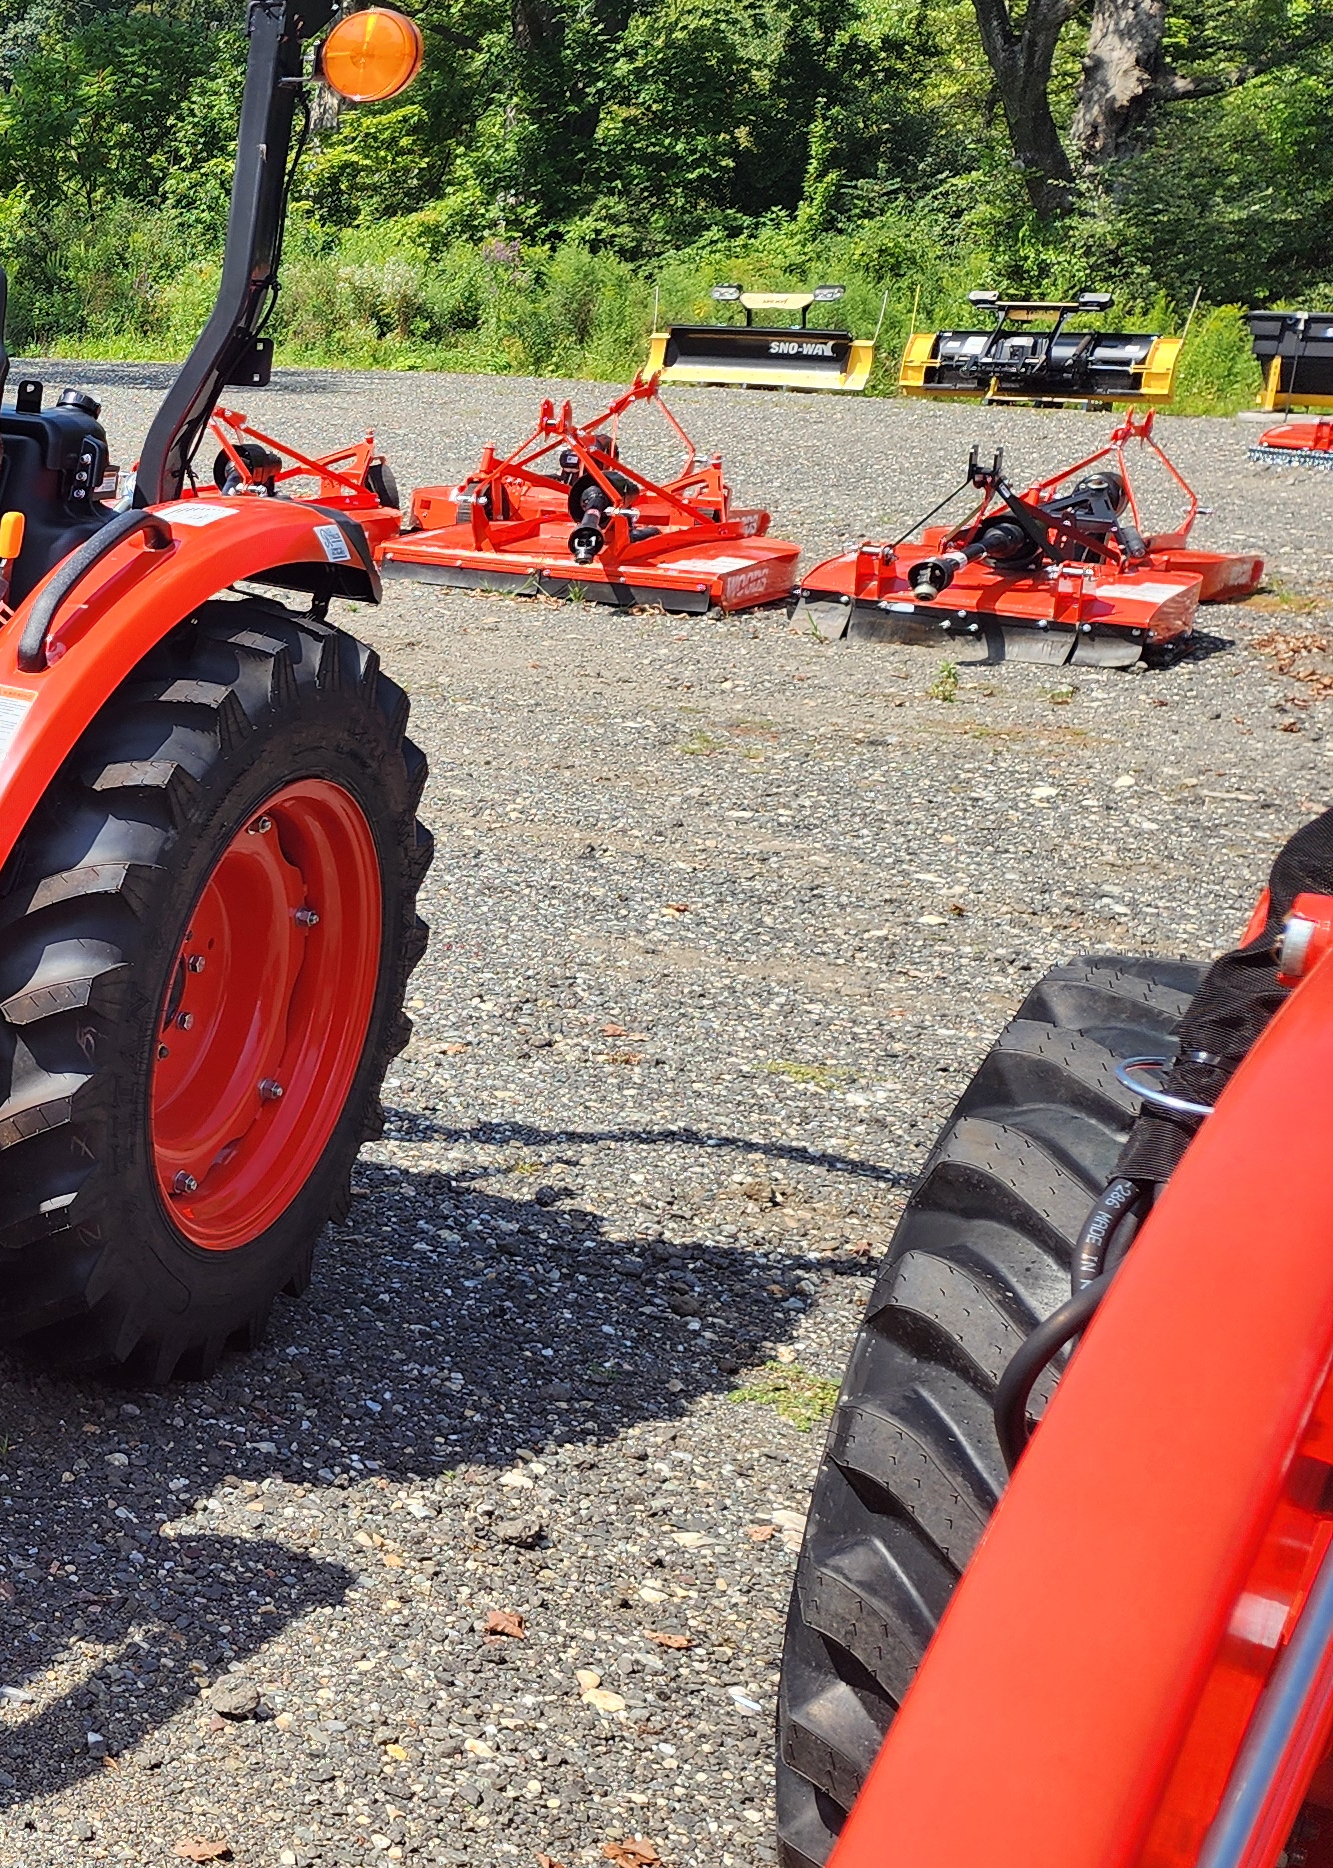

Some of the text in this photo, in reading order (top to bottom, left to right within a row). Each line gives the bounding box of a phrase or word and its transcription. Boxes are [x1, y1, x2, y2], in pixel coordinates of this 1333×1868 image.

[769, 341, 836, 356] SNO-WAY
[1085, 1210, 1113, 1247] MADE
[1079, 1253, 1099, 1273] IN
